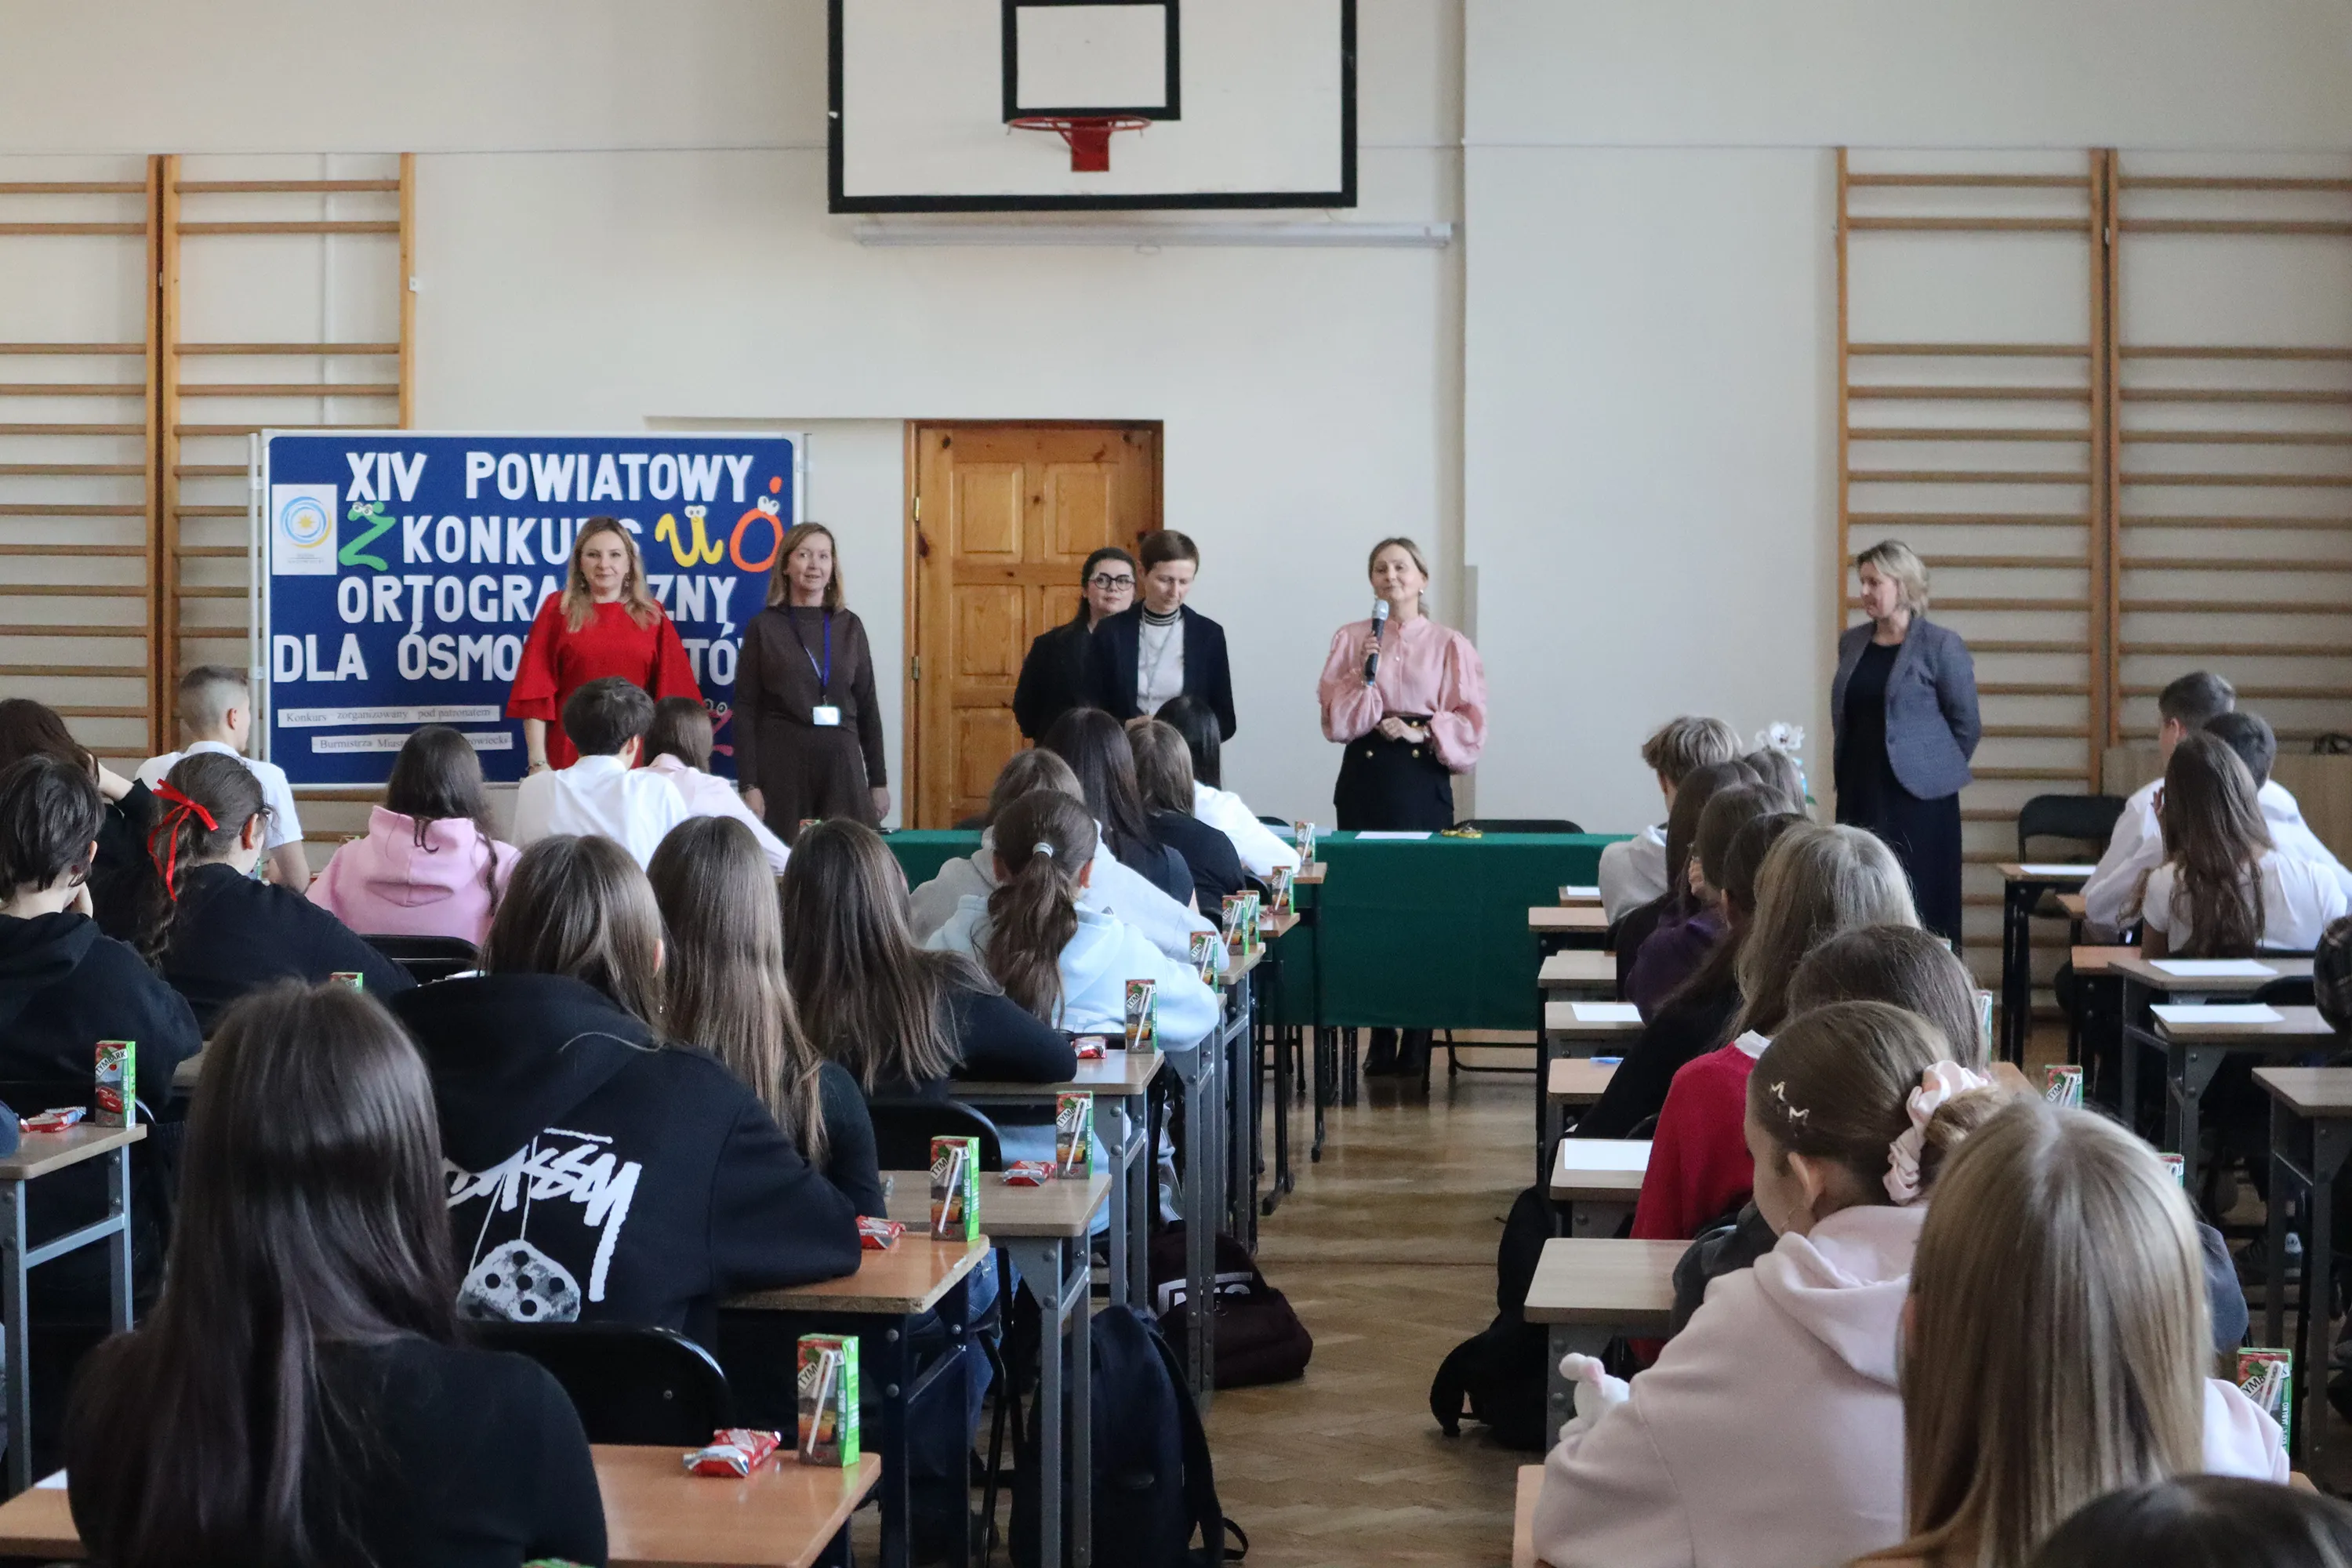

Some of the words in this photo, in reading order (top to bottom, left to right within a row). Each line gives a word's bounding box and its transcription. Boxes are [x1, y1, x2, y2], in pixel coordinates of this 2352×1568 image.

[346, 452, 427, 502] XIV
[466, 452, 753, 502] POWIATOWY
[403, 515, 643, 565] KONKU
[274, 633, 368, 682] DLA
[287, 713, 326, 722] Konkurs
[337, 710, 408, 721] zorganizowany
[418, 709, 435, 720] pod
[438, 707, 491, 719] patronatem
[320, 739, 372, 749] Burmistrza
[96, 1051, 125, 1073] TYMBARK
